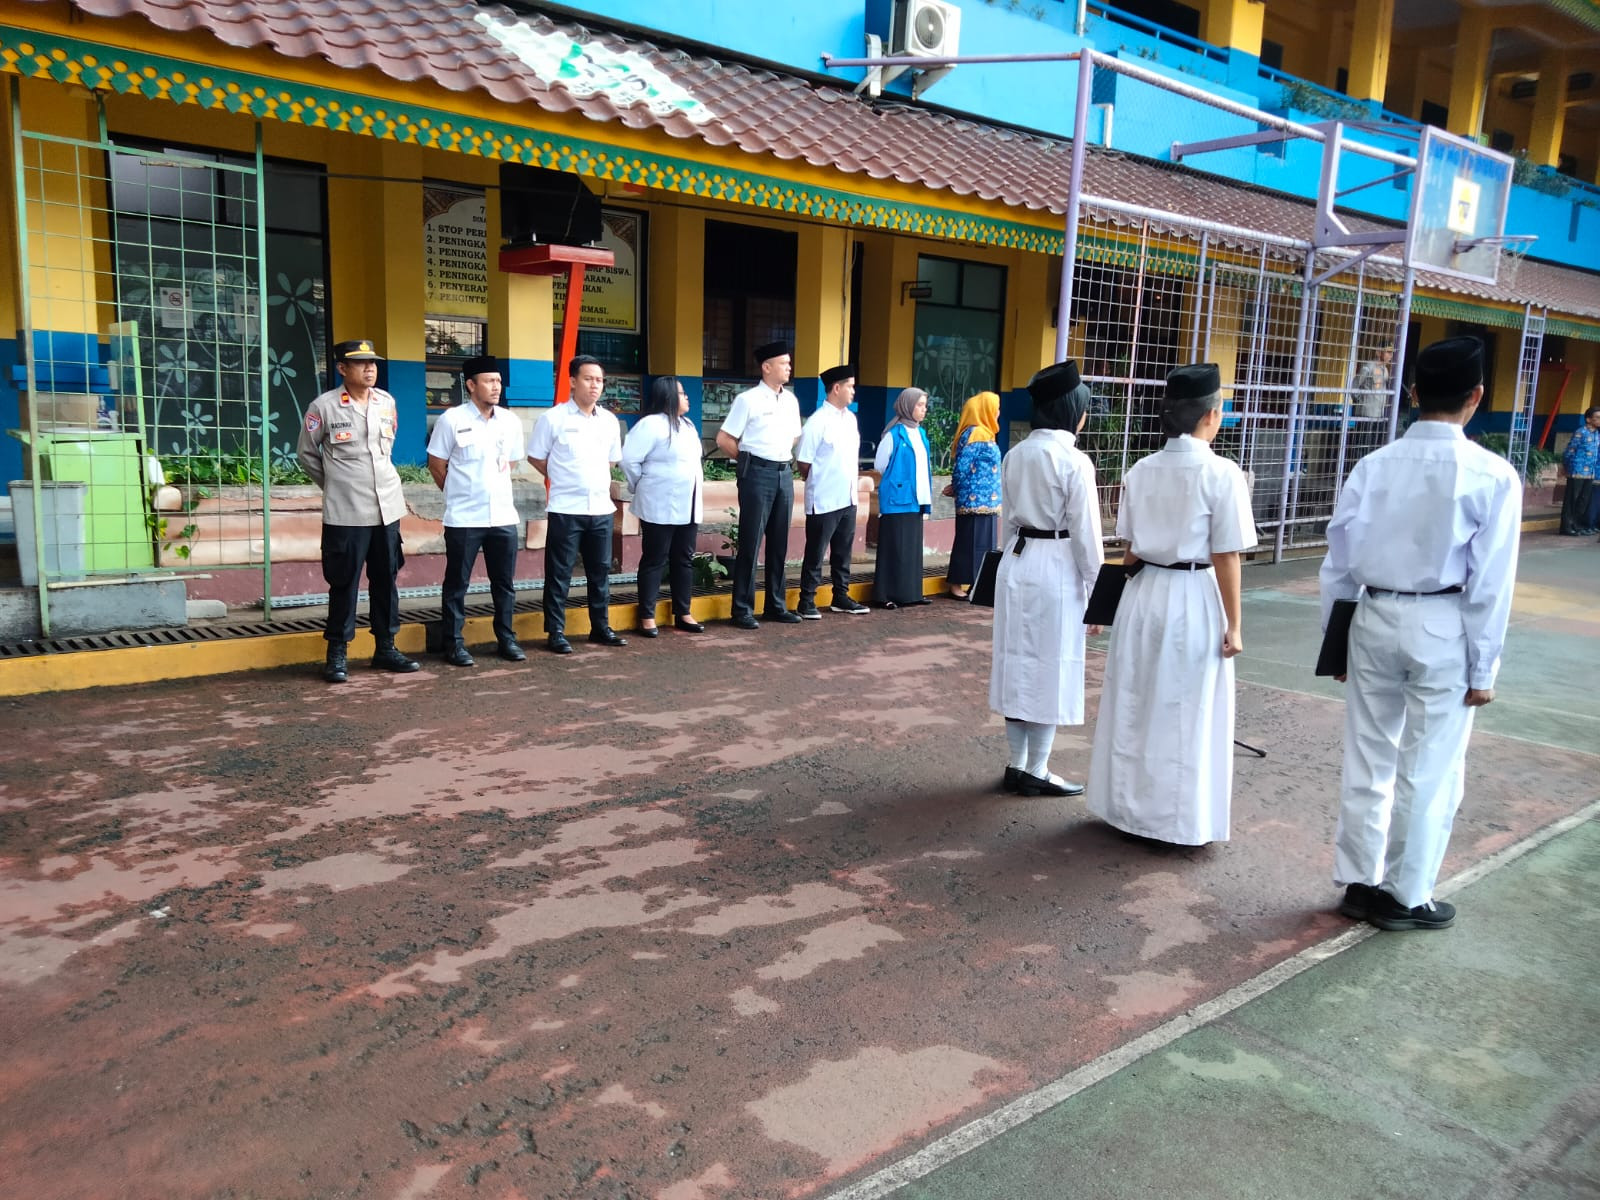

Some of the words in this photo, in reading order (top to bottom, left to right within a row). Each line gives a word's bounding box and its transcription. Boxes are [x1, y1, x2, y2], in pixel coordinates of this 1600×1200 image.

[427, 223, 435, 232] 1.
[438, 224, 463, 235] STOP
[438, 236, 486, 249] PENINGKA
[439, 247, 486, 260] PENINGKA
[439, 258, 487, 271] PENINGKA
[439, 270, 487, 282] PENINGKA
[440, 293, 488, 304] PENGINTE
